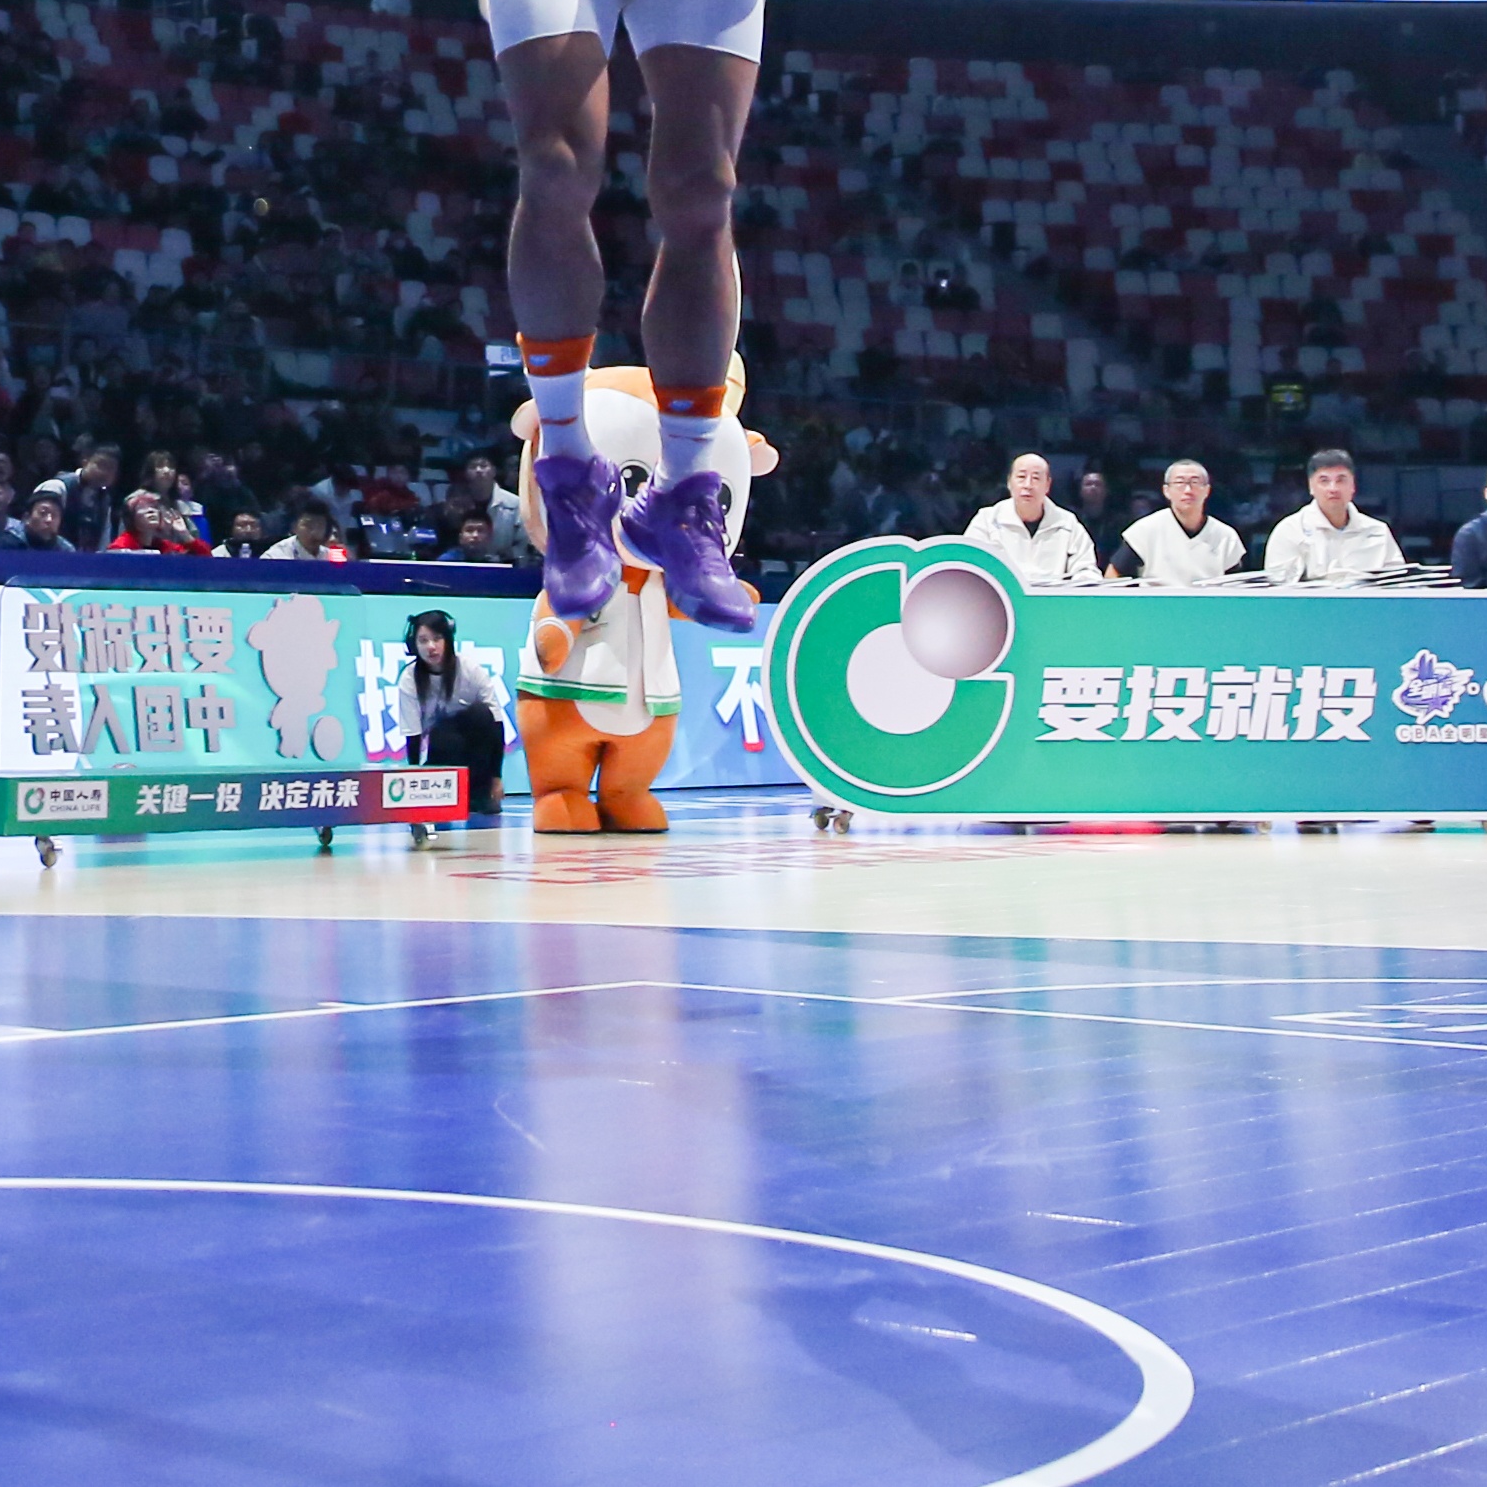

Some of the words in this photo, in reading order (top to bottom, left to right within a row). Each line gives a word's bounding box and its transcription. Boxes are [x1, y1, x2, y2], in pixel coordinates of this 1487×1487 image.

[1035, 665, 1376, 742] 要投就投
[409, 778, 453, 793] 中国人寿
[49, 788, 103, 803] 中国人寿
[135, 781, 242, 815] 关键一投
[259, 777, 360, 811] 决定未来
[409, 792, 433, 801] CHINA
[434, 791, 453, 800] LIFE
[49, 804, 79, 813] CHINA
[81, 803, 102, 812] LIFE
